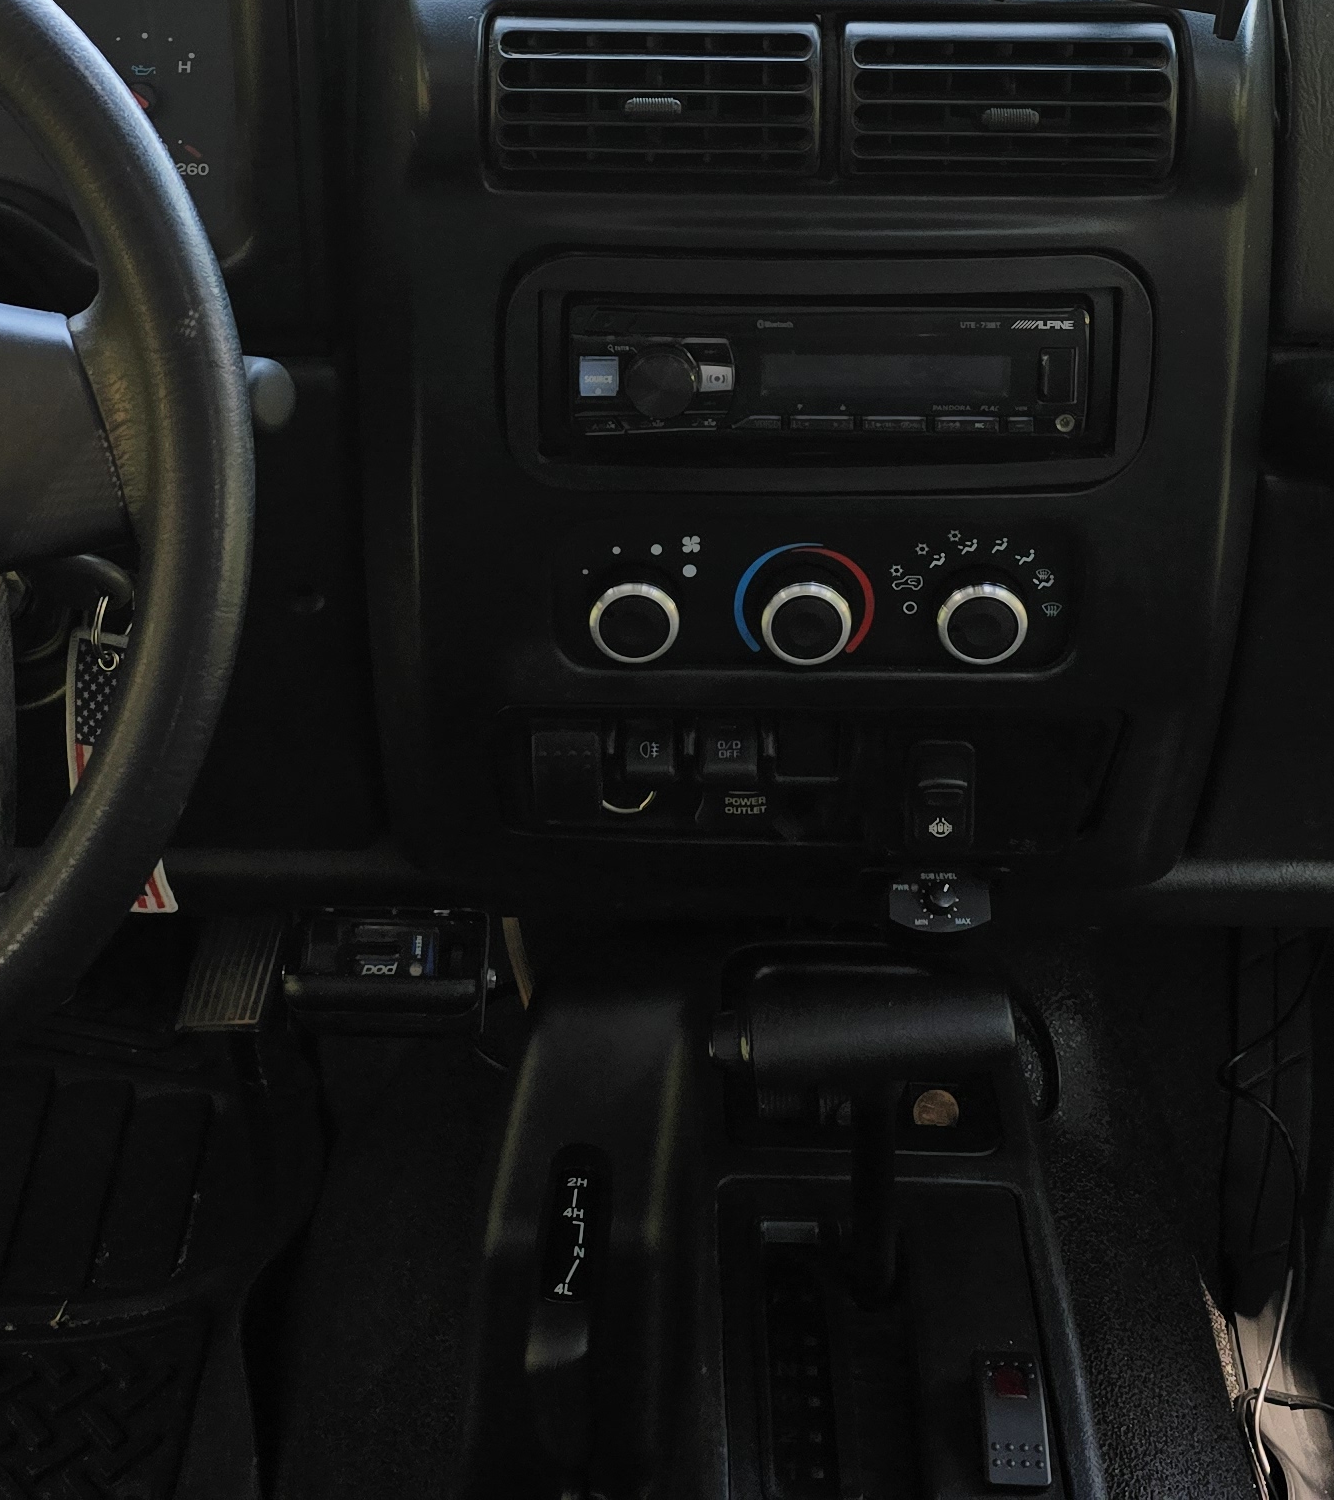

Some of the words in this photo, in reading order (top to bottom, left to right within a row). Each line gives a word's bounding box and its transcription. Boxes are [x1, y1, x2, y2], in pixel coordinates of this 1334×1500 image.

[177, 61, 192, 74] H
[177, 162, 210, 176] 260
[717, 740, 742, 750] O/D
[718, 749, 741, 759] OFF
[725, 796, 767, 806] POWER
[725, 805, 768, 815] OUTLET
[955, 917, 971, 925] MAX
[360, 961, 398, 976] pod
[567, 1177, 588, 1188] 2H
[562, 1207, 585, 1219] 4H
[573, 1245, 585, 1259] N
[553, 1282, 573, 1296] 4L
